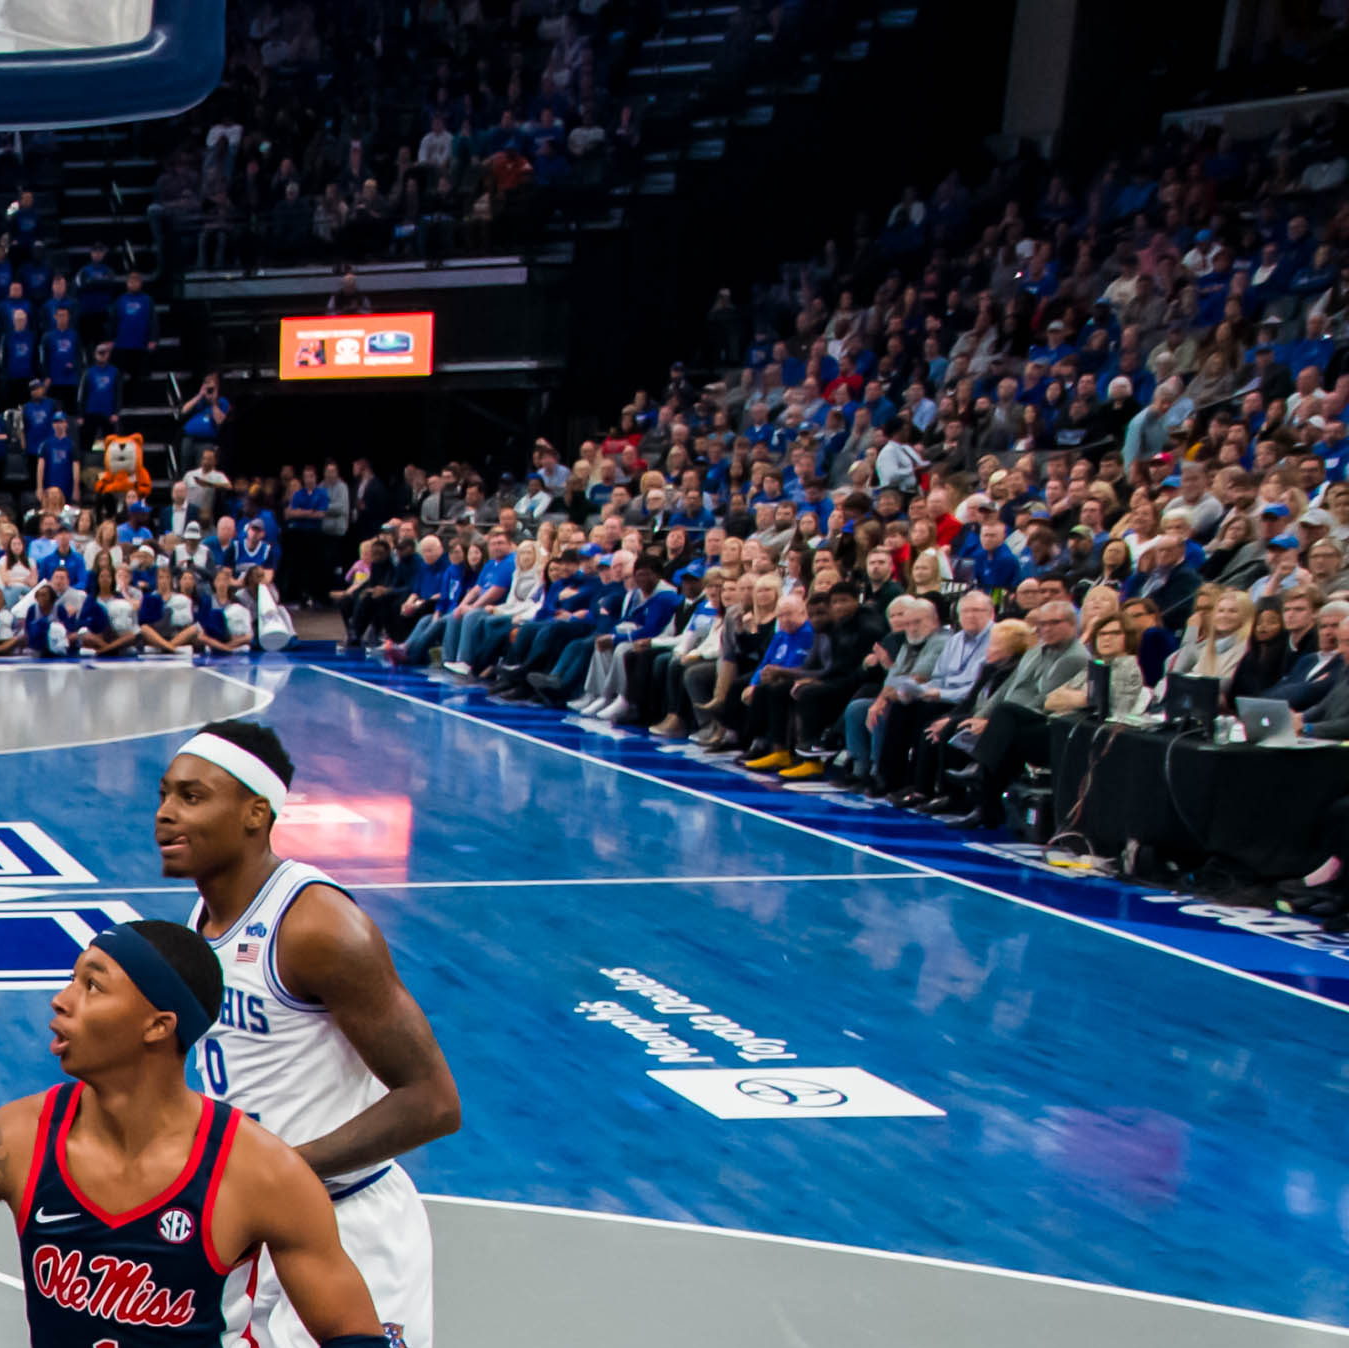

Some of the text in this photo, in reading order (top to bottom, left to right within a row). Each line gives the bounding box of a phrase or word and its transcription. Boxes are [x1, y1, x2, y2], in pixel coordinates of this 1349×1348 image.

[574, 1001, 715, 1062] Memphis
[599, 967, 797, 1062] Toyota Dealers
[160, 1210, 192, 1241] SEC
[32, 1244, 196, 1327] Ole Miss
